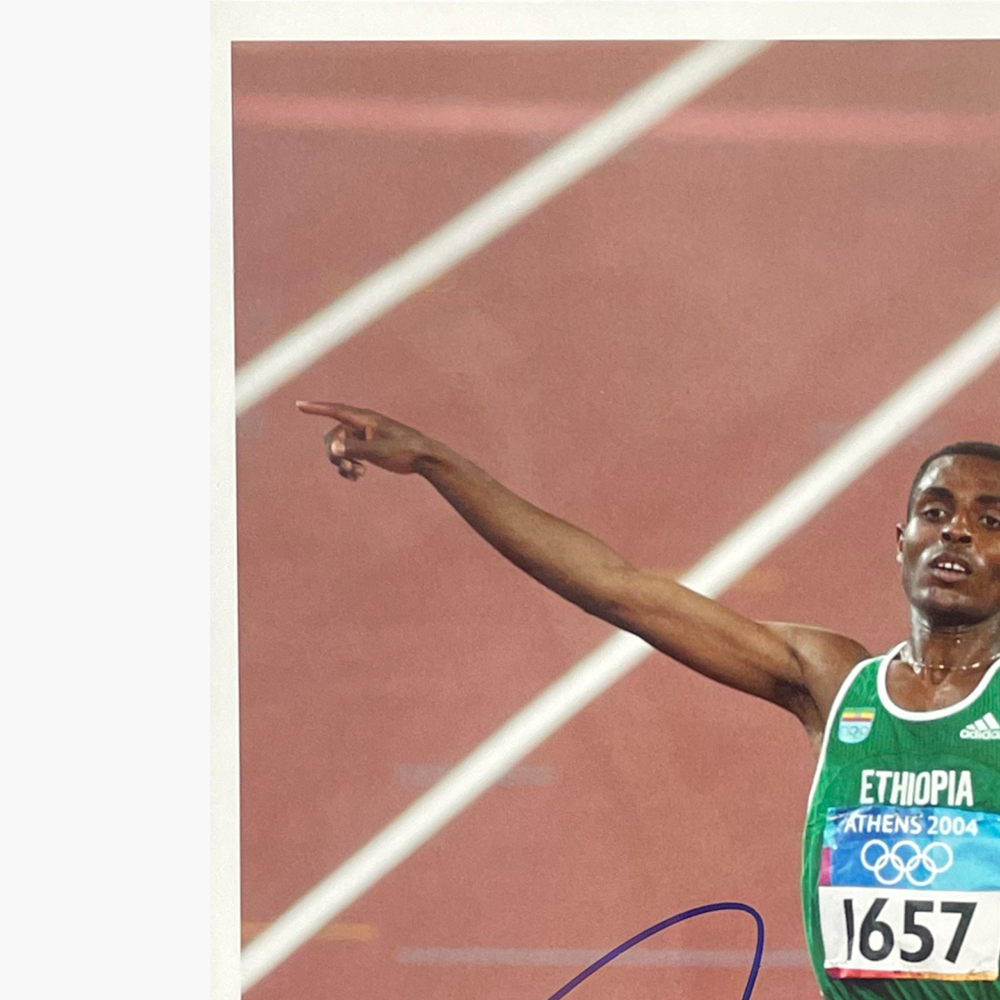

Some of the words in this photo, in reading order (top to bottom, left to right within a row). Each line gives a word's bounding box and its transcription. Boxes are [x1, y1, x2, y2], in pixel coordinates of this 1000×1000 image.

[859, 769, 974, 807] ETHIOPIA
[844, 814, 922, 835] ATHENS
[927, 815, 979, 837] 2004
[842, 897, 978, 965] 1657
